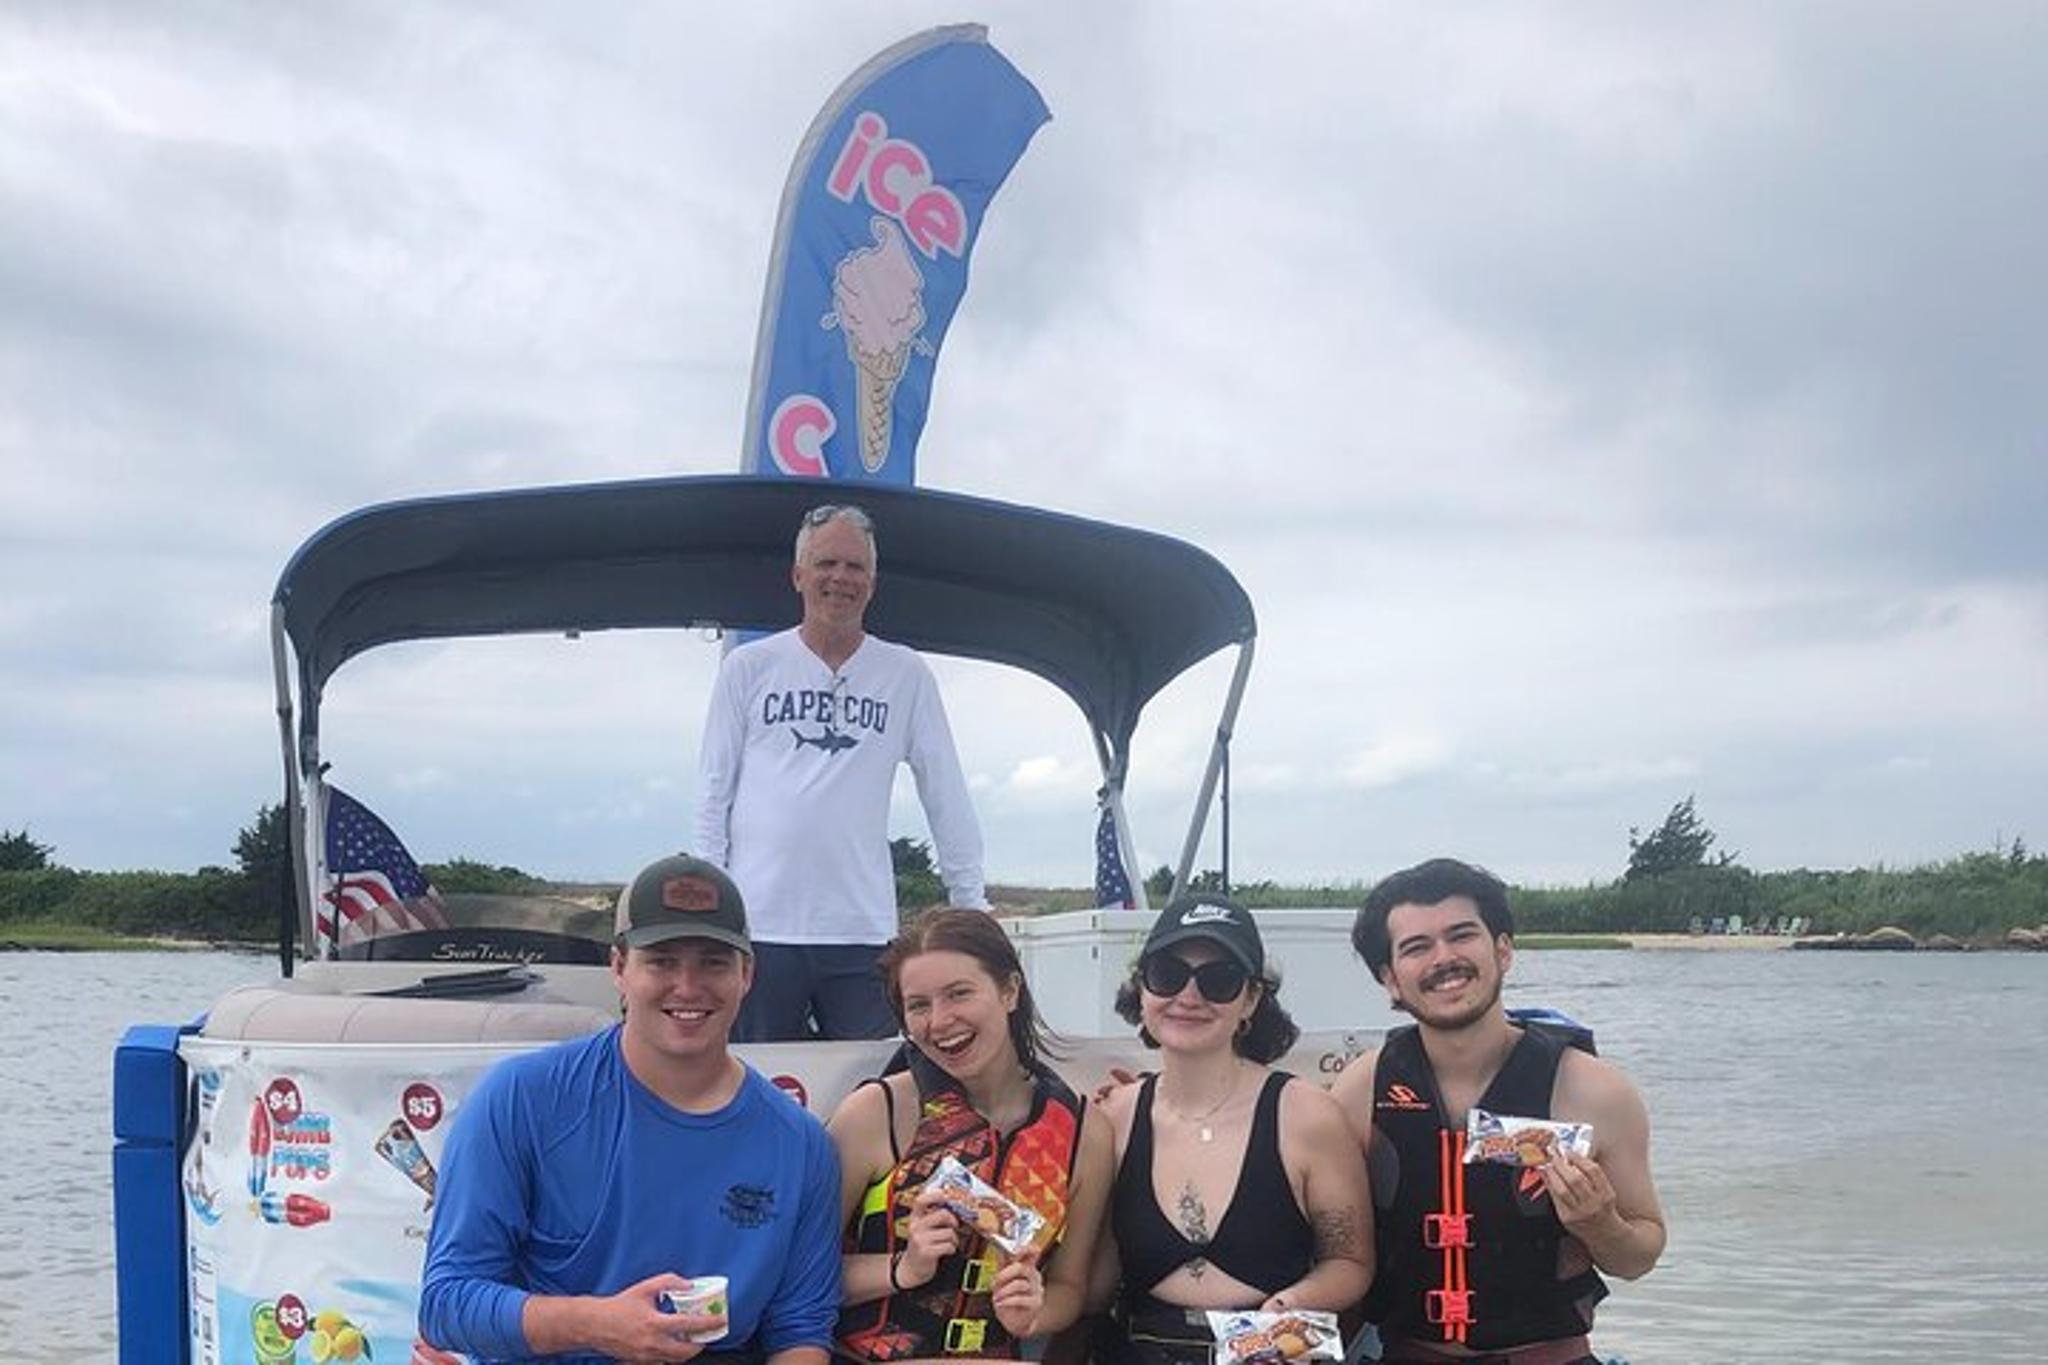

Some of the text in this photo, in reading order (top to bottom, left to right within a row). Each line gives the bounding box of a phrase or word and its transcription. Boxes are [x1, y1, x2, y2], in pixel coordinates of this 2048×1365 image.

[764, 690, 888, 734] CAPE COD
[408, 1096, 437, 1118] $5
